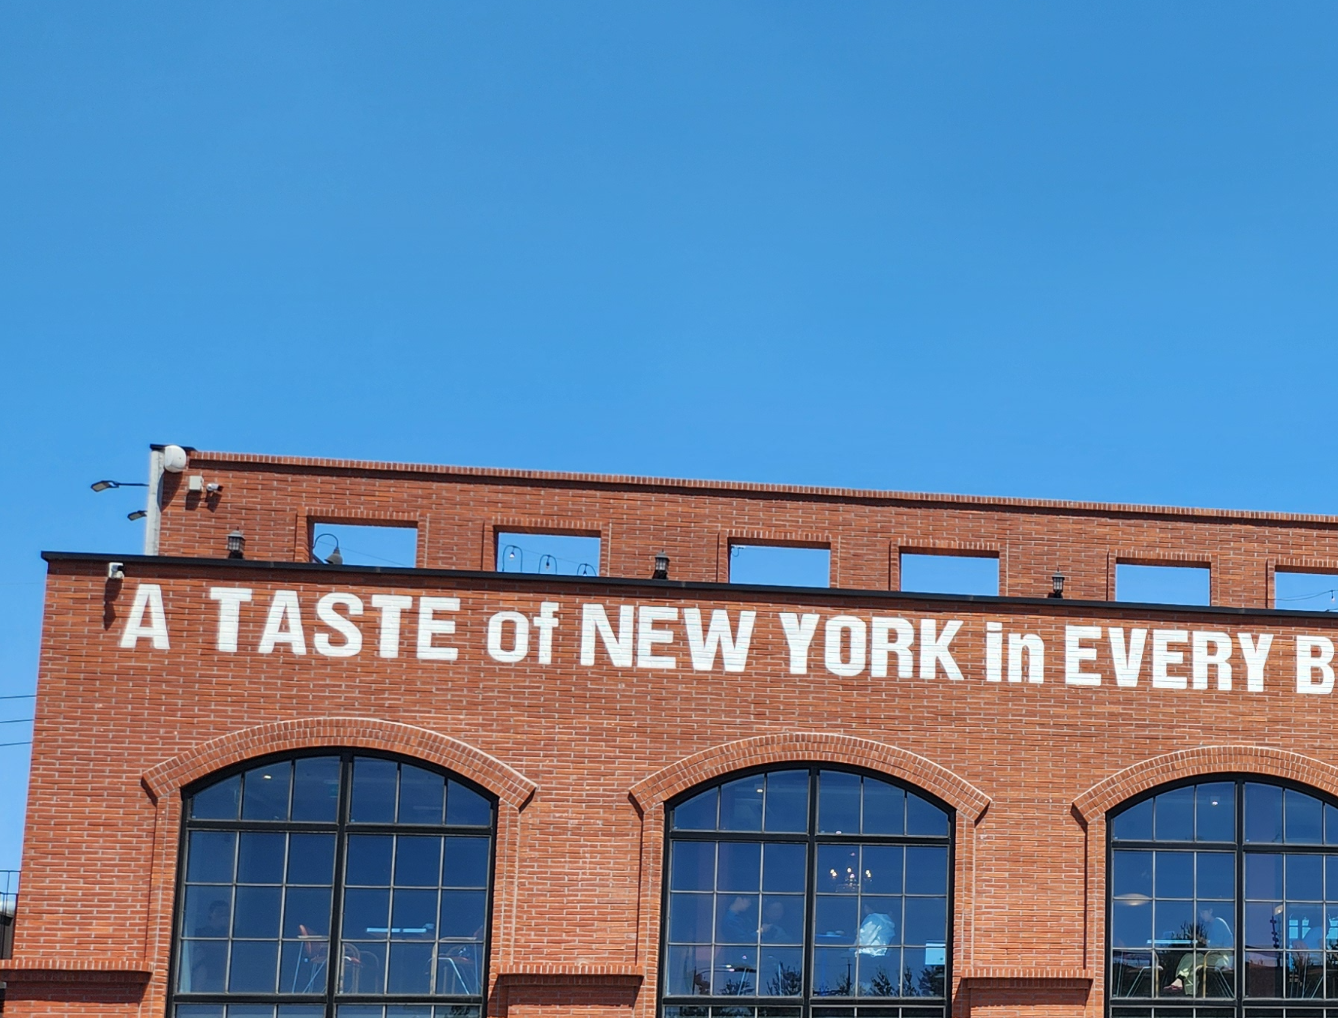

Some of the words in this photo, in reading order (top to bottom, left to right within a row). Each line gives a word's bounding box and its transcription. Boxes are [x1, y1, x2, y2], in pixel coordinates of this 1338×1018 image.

[120, 583, 170, 650] A
[210, 586, 461, 661] TASTE
[487, 601, 559, 666] of
[580, 602, 755, 673] NEW
[779, 611, 964, 682] YORK
[986, 621, 1045, 685] in
[1064, 625, 1274, 693] EVERY
